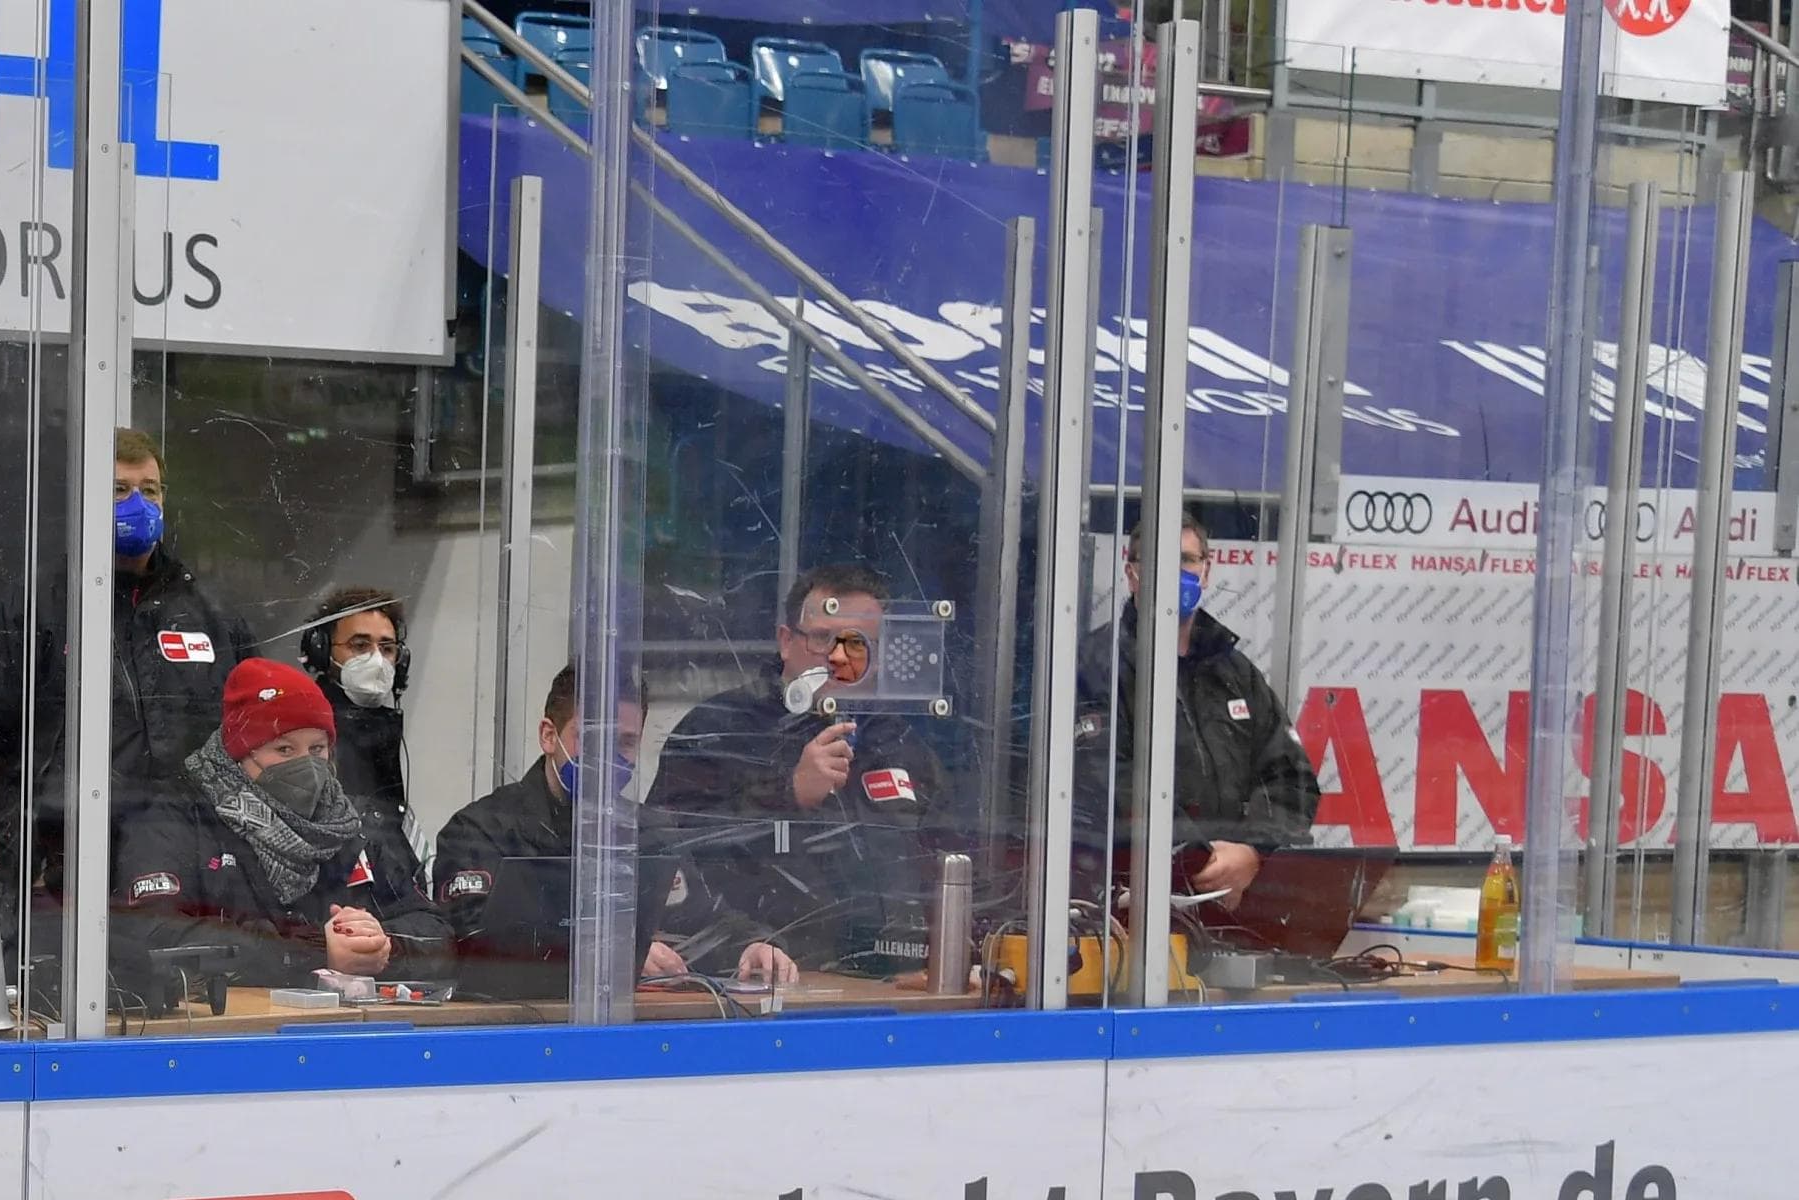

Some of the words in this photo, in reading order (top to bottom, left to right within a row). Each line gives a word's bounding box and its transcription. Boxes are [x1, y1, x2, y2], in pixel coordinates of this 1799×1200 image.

[1450, 498, 1538, 534] Audi
[1674, 506, 1757, 541] Adi
[1350, 554, 1396, 570] FLEX
[1411, 556, 1477, 573] HANSA
[1490, 557, 1536, 574] FLEX
[1747, 565, 1790, 582] FLEX
[1293, 686, 1799, 848] ANSA
